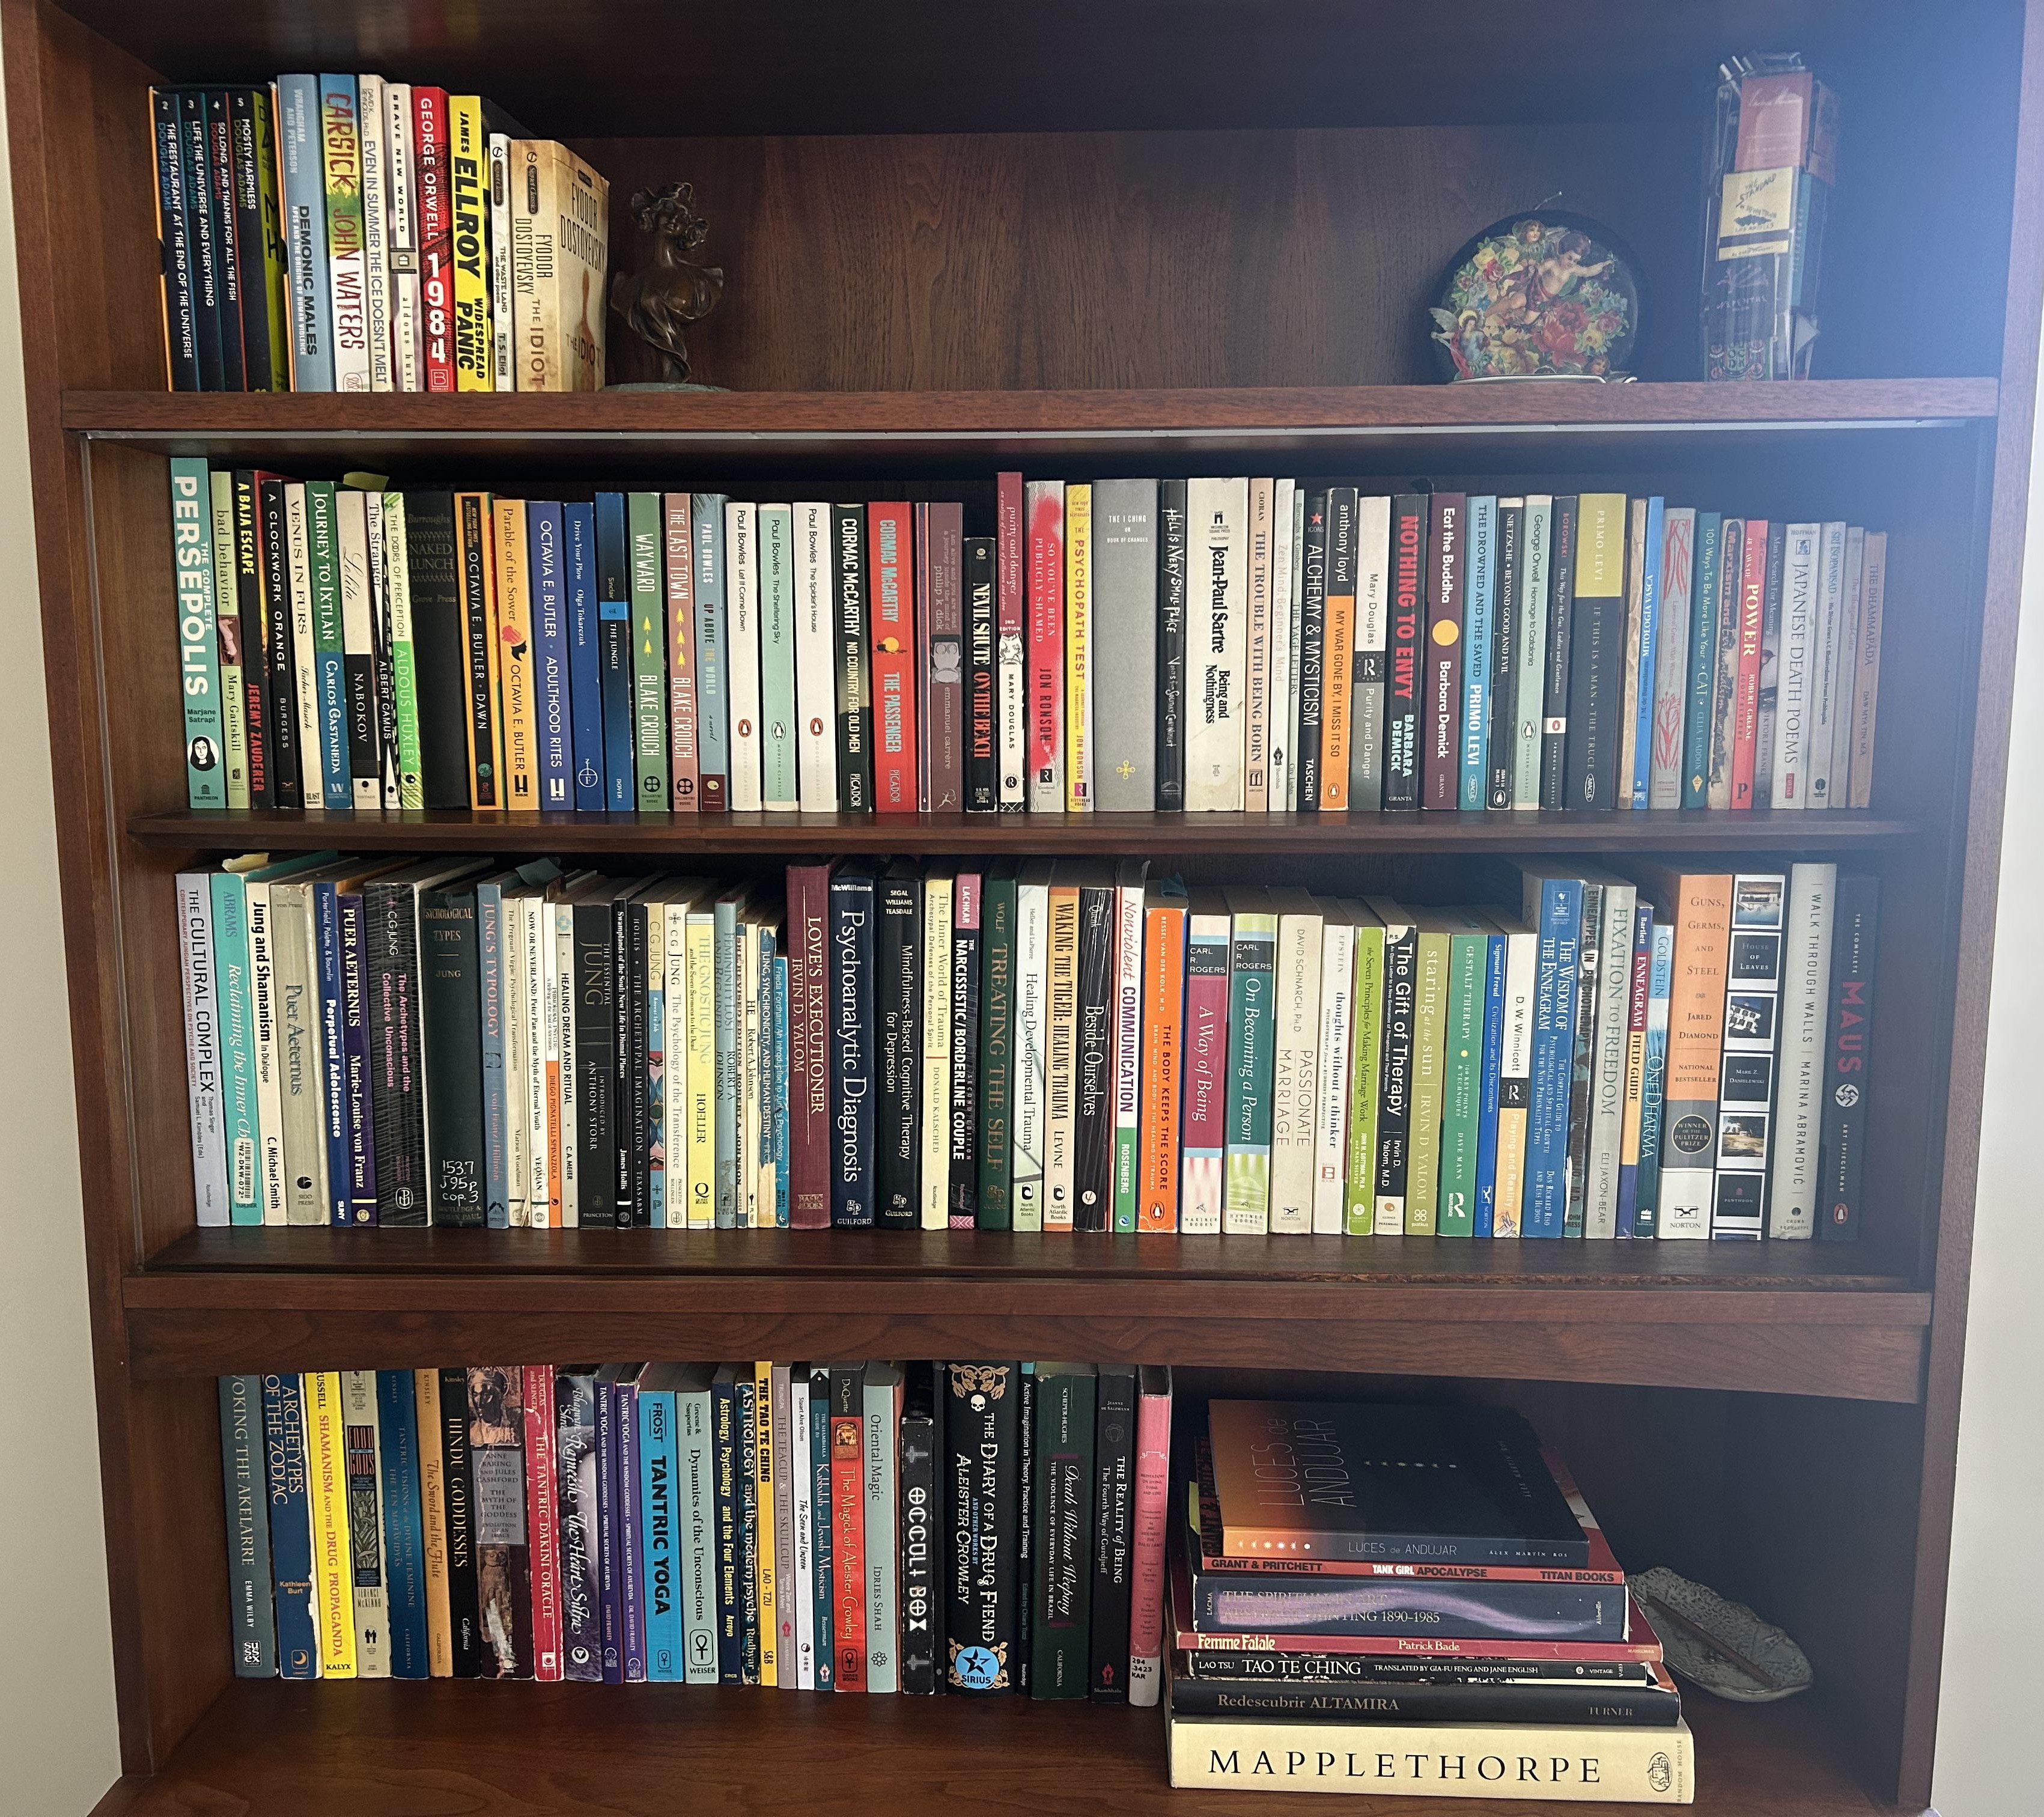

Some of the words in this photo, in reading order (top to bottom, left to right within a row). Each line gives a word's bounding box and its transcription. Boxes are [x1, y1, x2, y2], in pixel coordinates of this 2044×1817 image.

[167, 123, 175, 137] THE
[326, 93, 355, 190] CARSICK
[421, 98, 435, 166] GEORGE
[460, 112, 469, 153] JAMES
[168, 137, 181, 212] RESTAURANT
[172, 213, 182, 227] AT
[425, 172, 439, 240] ORWELL
[454, 157, 482, 279] ELLROY
[176, 246, 185, 270] END
[300, 206, 314, 290] DEMONIC
[333, 208, 360, 260] JOHN
[515, 218, 534, 295] DOSTOYEVSKY
[535, 234, 553, 278] FYODOR
[178, 273, 186, 288] OF
[181, 306, 193, 359] UNIVERSE
[303, 296, 317, 355] MALES
[336, 272, 364, 348] WATERS
[428, 254, 446, 364] 1984
[532, 300, 541, 322] THE
[457, 301, 475, 370] PANIC
[473, 298, 484, 379] WIDESPREAD
[530, 327, 546, 385] IDIOT
[737, 510, 746, 528] Paul
[841, 519, 857, 568] CORMAC
[1596, 510, 1605, 549] PRIMO
[270, 511, 282, 602] CLOCKWORK
[636, 533, 655, 592] WAYWARD
[737, 532, 746, 565] Bowles
[1255, 531, 1265, 560] THE
[1398, 516, 1420, 607] NOTHING
[1595, 554, 1604, 581] LEVI
[174, 476, 208, 696] PERSEPOLIS
[203, 568, 213, 630] COMPLETE
[1208, 546, 1228, 609] Jean-Paul
[1254, 565, 1265, 631] TROUBLE
[1306, 544, 1322, 620] ALCHEMY
[1369, 573, 1378, 598] Mary
[1646, 574, 1654, 602] VASCA
[1790, 562, 1809, 641] JAPANESE
[844, 572, 860, 636] McCARTHY
[1367, 601, 1377, 644] Douglas
[1396, 615, 1416, 638] TO
[1743, 583, 1759, 657] POWER
[275, 610, 285, 671] ORANGE
[1211, 612, 1228, 654] Sartre
[1253, 637, 1264, 672] WITH
[1306, 624, 1321, 635] &
[1642, 603, 1652, 657] MITOLOGÍA
[1252, 677, 1264, 717] BEING
[1303, 642, 1321, 726] MYSTICISM
[1395, 645, 1414, 699] ENVY
[1787, 647, 1805, 705] DEATH
[280, 698, 289, 748] BURGESS
[355, 673, 367, 743] NABOKOV
[1252, 721, 1262, 762] BORN
[1784, 708, 1802, 764] POEMS
[851, 774, 861, 807] PICADOR
[1306, 758, 1314, 801] TASCHEN
[188, 889, 200, 914] THE
[253, 903, 267, 933] Jung
[190, 918, 207, 1006] CULTURAL
[255, 936, 269, 963] and
[808, 917, 823, 977] LOVE'S
[254, 966, 272, 1042] Shamanism
[792, 958, 803, 1001] IRVIN
[838, 910, 865, 1071] Psychoanalytic
[793, 1006, 804, 1018] D.
[953, 940, 968, 1107] NARCISSISTIC/BORDERLINE
[1837, 982, 1866, 1072] MAUS
[197, 1011, 215, 1092] COMPLEX
[261, 1055, 269, 1083] Dialogue
[793, 1022, 805, 1073] YALOM
[809, 982, 824, 1114] EXECUTIONER
[1119, 987, 1136, 1113] COMMUNICATION
[696, 1094, 706, 1143] HOELLER
[1276, 1050, 1292, 1146] MARRIAGE
[1298, 1050, 1313, 1147] PASSIONATE
[838, 1076, 866, 1183] Diagnosis
[953, 1112, 966, 1160] COUPLE
[1053, 1131, 1062, 1168] LEVINE
[443, 1160, 474, 1175] 153.7
[1120, 1143, 1129, 1193] ROSENBERG
[469, 1190, 478, 1202] 3
[652, 1403, 663, 1443] FROST
[319, 1415, 333, 1493] SHAMANISM
[651, 1456, 668, 1550] TANTRIC
[1211, 1559, 1248, 1569] GRANT
[1251, 1561, 1260, 1569] &
[1262, 1562, 1322, 1572] PRITCHETT
[1348, 1542, 1386, 1554] LUCES
[1372, 1565, 1394, 1575] TANK
[1395, 1566, 1415, 1575] GIRL
[1417, 1567, 1487, 1578] APOCALYPSE
[245, 1580, 253, 1602] EMMA
[654, 1554, 670, 1615] YOGA
[1541, 1571, 1572, 1581] TITAN
[1575, 1572, 1614, 1582] BOOKS
[329, 1572, 342, 1656] PROPAGANDA
[1197, 1635, 1240, 1651] Femme
[1242, 1636, 1276, 1651] Fatale
[1242, 1660, 1274, 1675] TAO
[1279, 1660, 1300, 1675] TE
[1305, 1660, 1361, 1676] CHING
[1398, 1640, 1433, 1651] Patrick
[1434, 1641, 1461, 1651] Bade
[961, 1675, 991, 1684] SIRIUS
[1217, 1694, 1305, 1710] Redescubrir
[1310, 1696, 1399, 1711] ALTAMIRA
[1588, 1706, 1633, 1717] TURNER
[1209, 1749, 1601, 1784] MAPPLETHORPE
